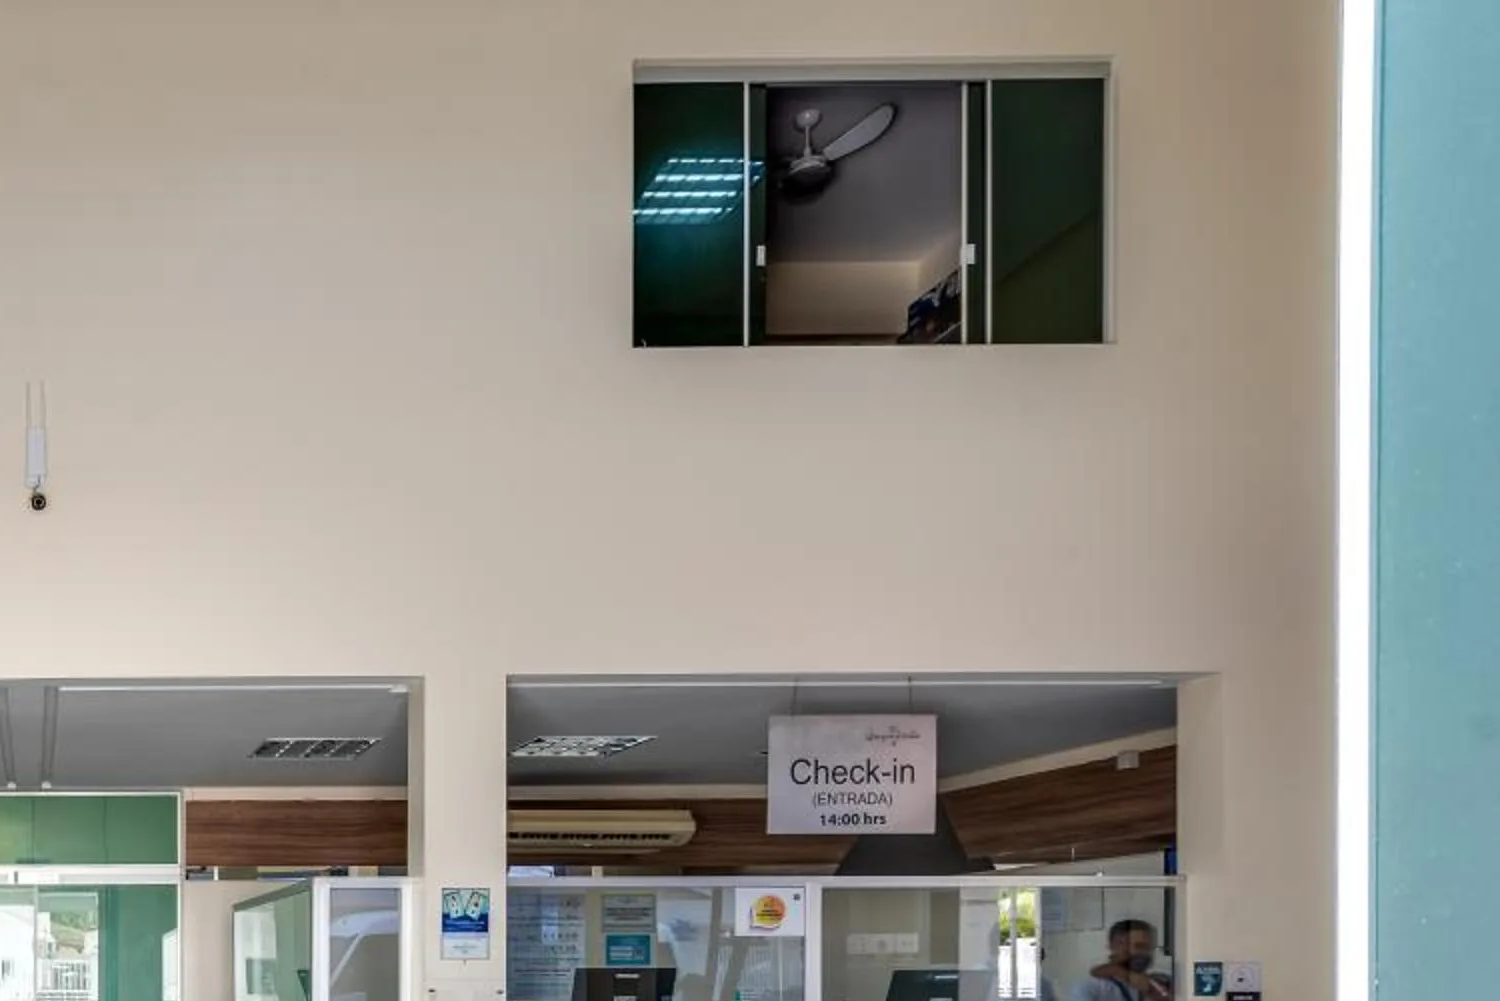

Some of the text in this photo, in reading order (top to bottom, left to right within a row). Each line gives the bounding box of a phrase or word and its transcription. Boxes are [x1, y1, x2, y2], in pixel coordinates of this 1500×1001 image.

[790, 758, 916, 785] Check-in
[812, 791, 893, 807] (ENTRADA)
[820, 812, 887, 826] 14:00 hrs
